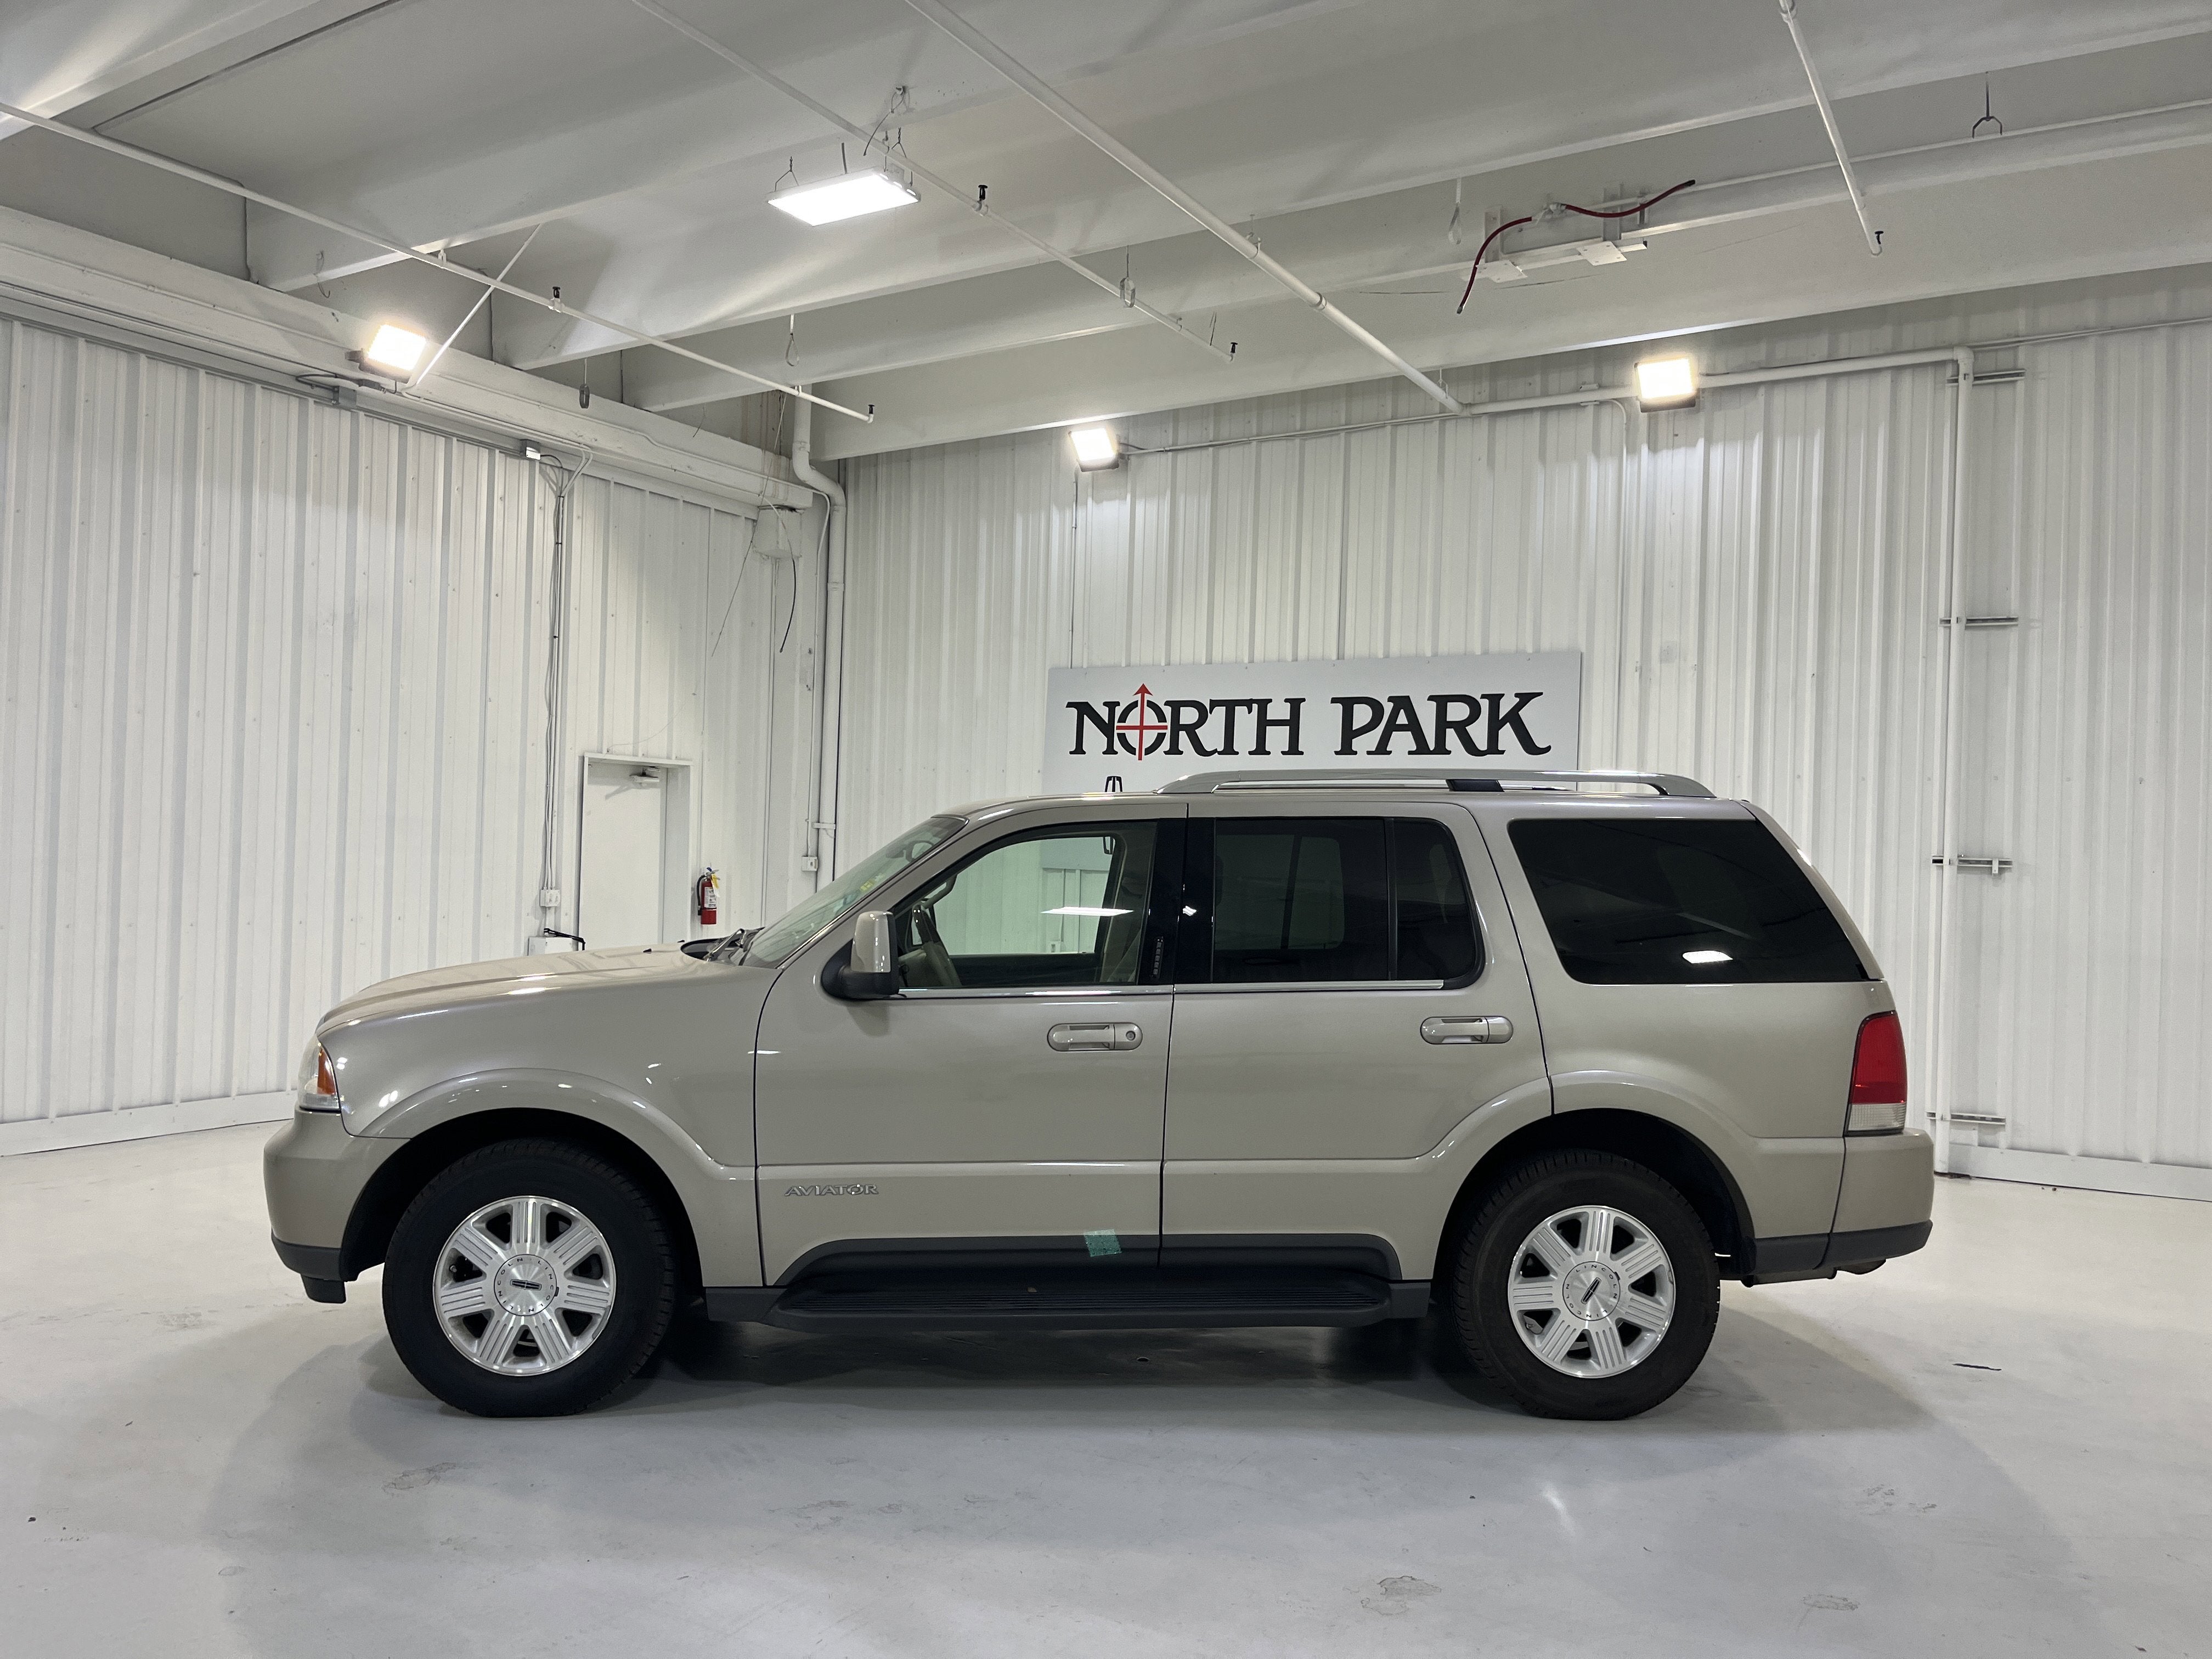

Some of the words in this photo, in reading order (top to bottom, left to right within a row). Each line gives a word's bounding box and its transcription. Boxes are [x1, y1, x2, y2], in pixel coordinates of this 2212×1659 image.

[1066, 697, 1306, 757] NORTH
[1331, 692, 1551, 757] PARK
[785, 1184, 879, 1197] AVIATOR
[498, 1257, 523, 1310] LINCOLN
[528, 1260, 554, 1312] LINCOLN
[1566, 1284, 1607, 1317] LINCOLN
[1576, 1265, 1617, 1299] LINCOLN
